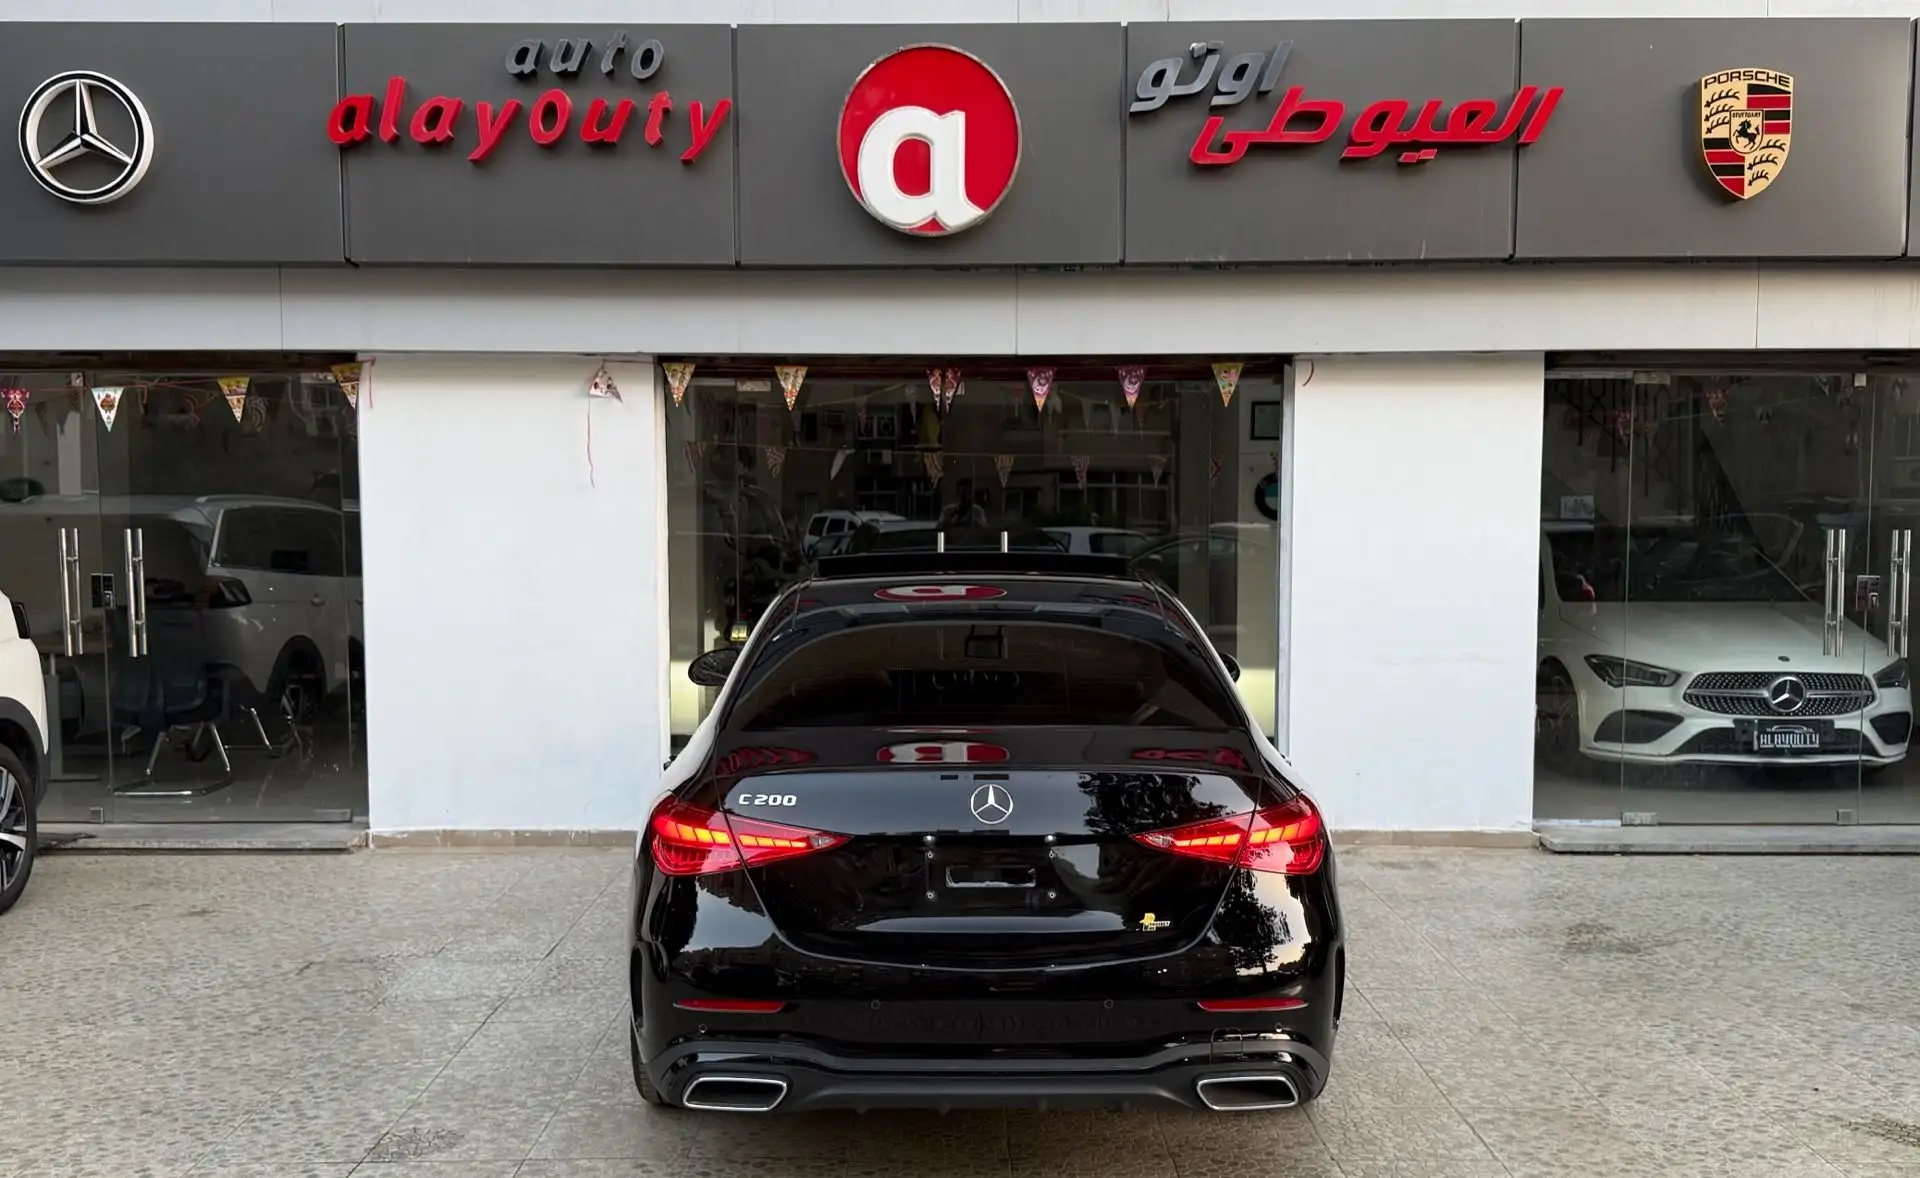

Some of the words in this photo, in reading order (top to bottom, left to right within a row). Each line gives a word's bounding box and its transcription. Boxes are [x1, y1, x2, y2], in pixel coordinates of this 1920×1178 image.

[504, 30, 667, 81] auto
[1129, 39, 1294, 113] اوتو
[1704, 70, 1790, 89] PORSCHE
[738, 794, 752, 805] C
[754, 794, 798, 806] 200
